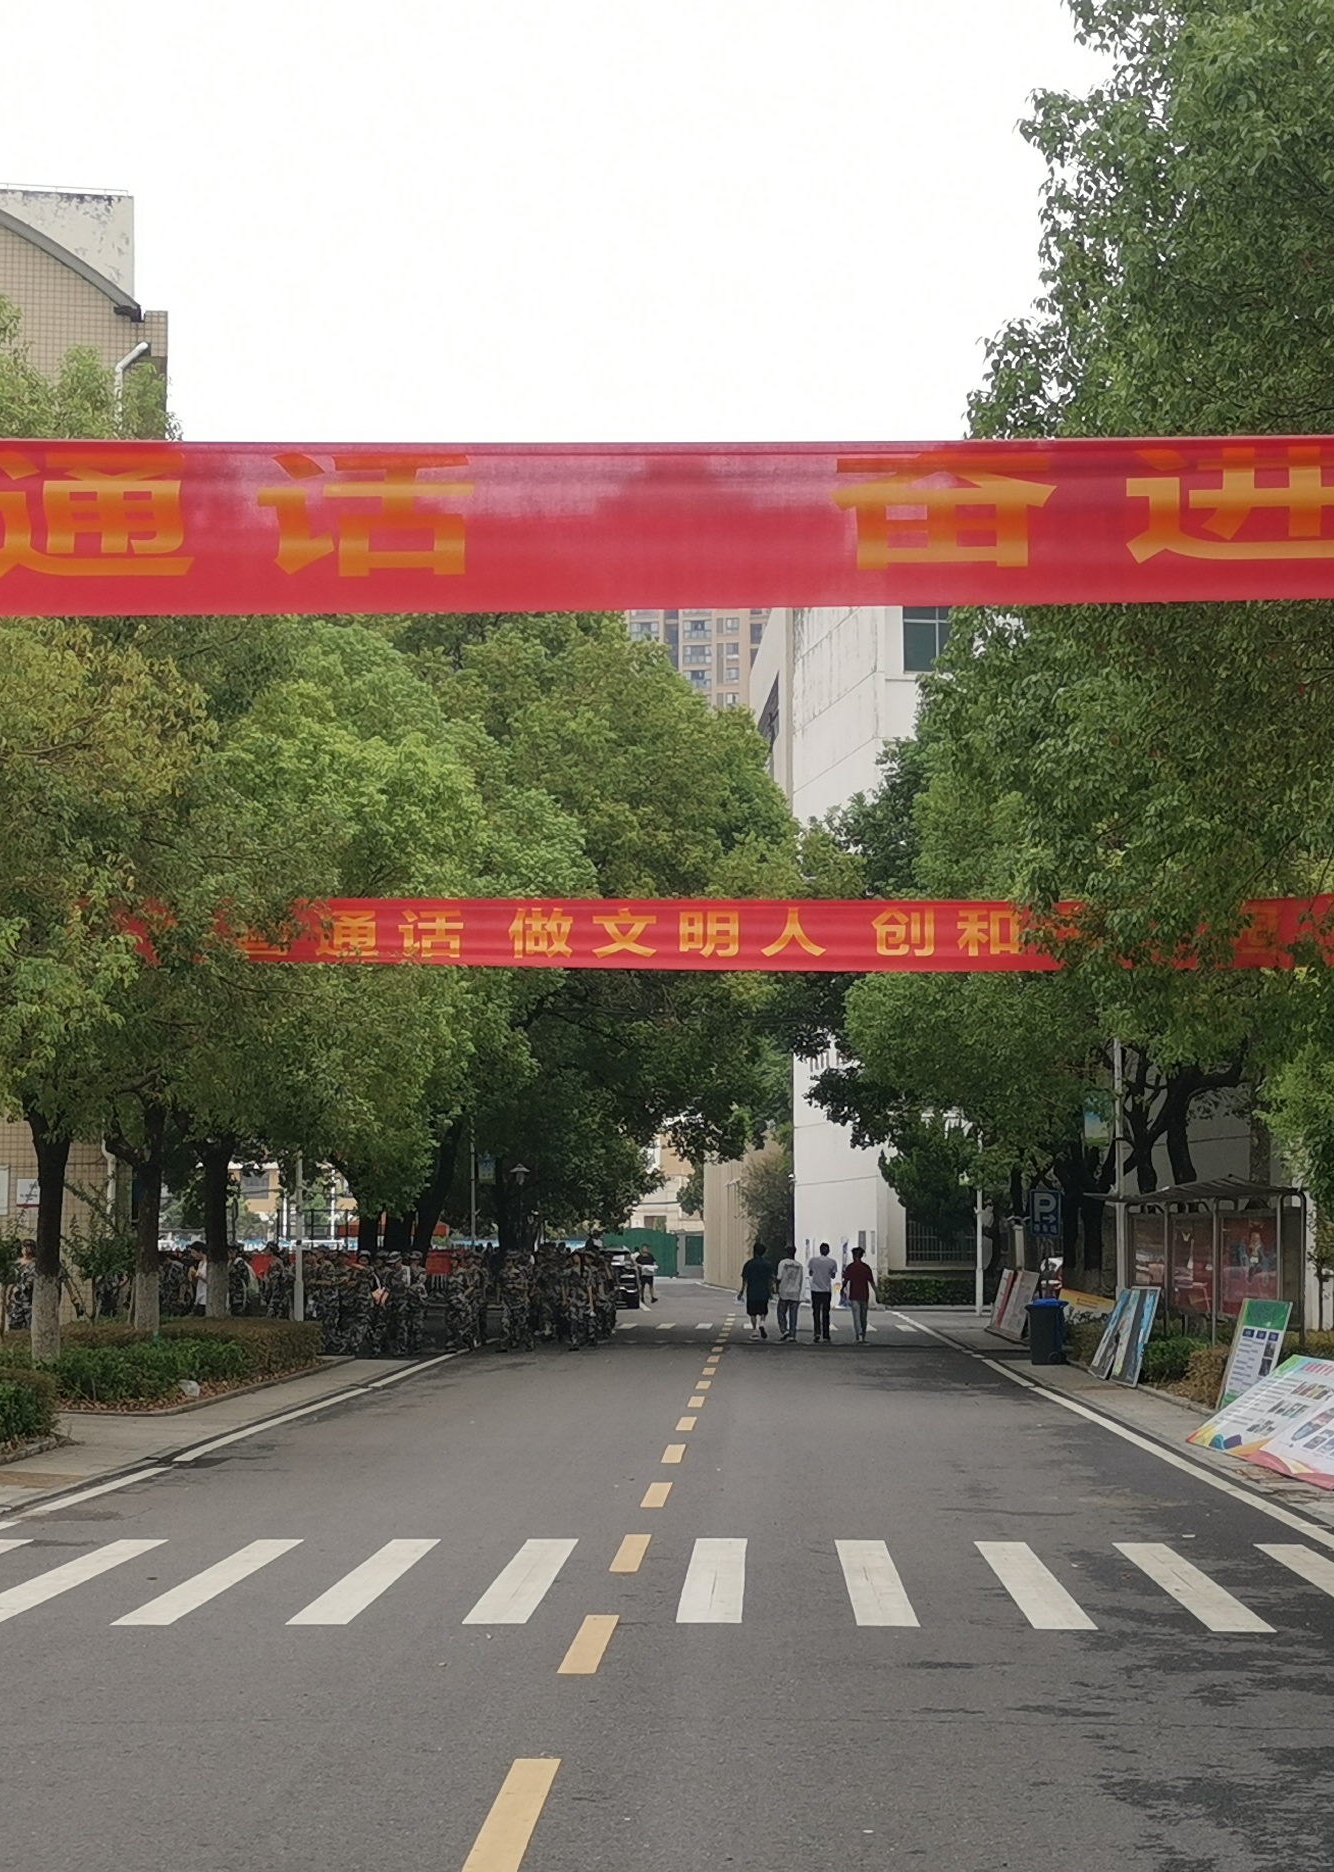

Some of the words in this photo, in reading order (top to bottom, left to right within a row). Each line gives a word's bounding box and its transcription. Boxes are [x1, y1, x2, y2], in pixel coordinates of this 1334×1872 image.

[508, 906, 826, 958] 做文明人
[1034, 1192, 1057, 1222] P
